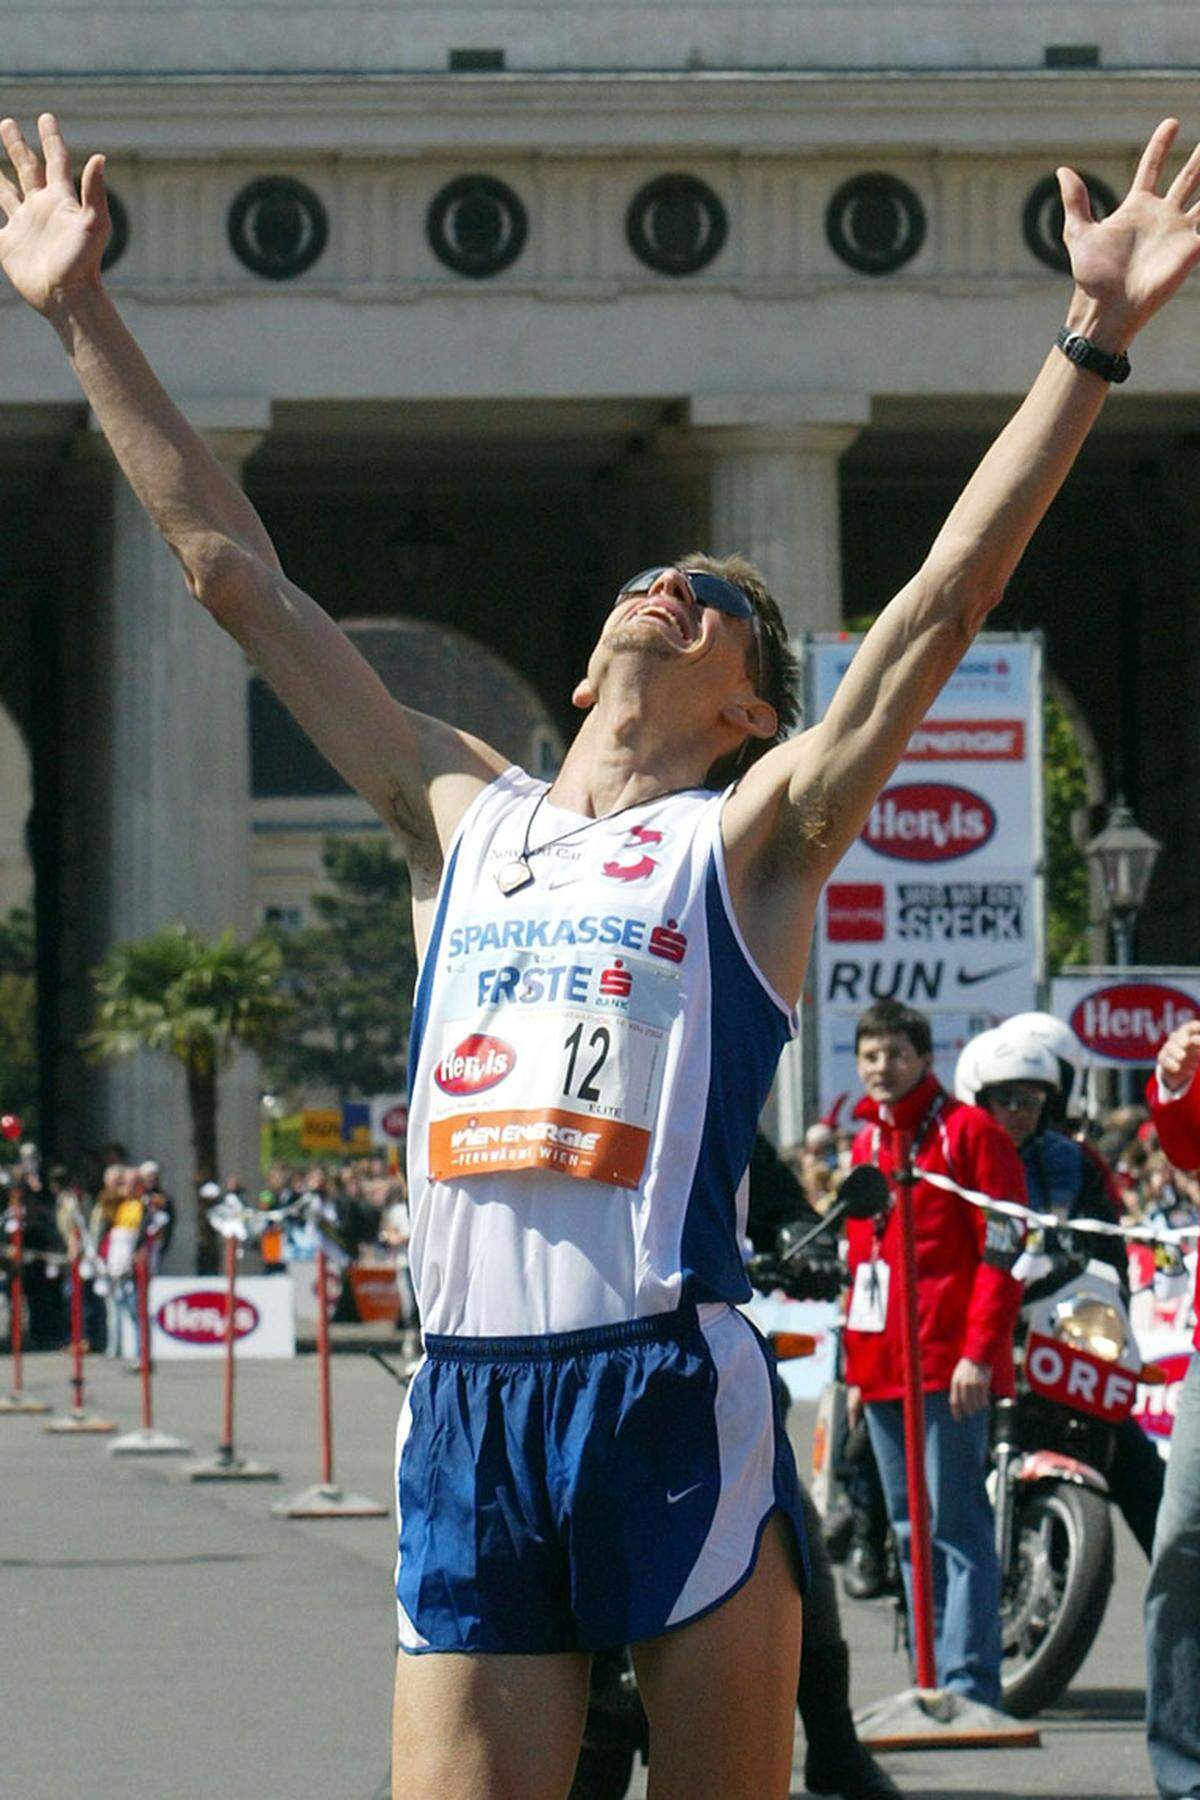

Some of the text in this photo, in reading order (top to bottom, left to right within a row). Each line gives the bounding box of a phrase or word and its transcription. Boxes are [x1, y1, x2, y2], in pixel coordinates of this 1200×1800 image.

[867, 799, 986, 847] Hervis
[448, 915, 646, 958] SPARKASSE
[900, 905, 1022, 941] SPECK
[477, 965, 593, 1007] ERSTE
[828, 961, 943, 1001] RUN
[440, 1049, 508, 1082] Hervis
[563, 1022, 611, 1102] 12
[589, 1103, 622, 1118] ELITE
[502, 1122, 602, 1151] ENERGIE
[538, 1147, 580, 1167] WIEN
[1029, 1346, 1133, 1410] ORF
